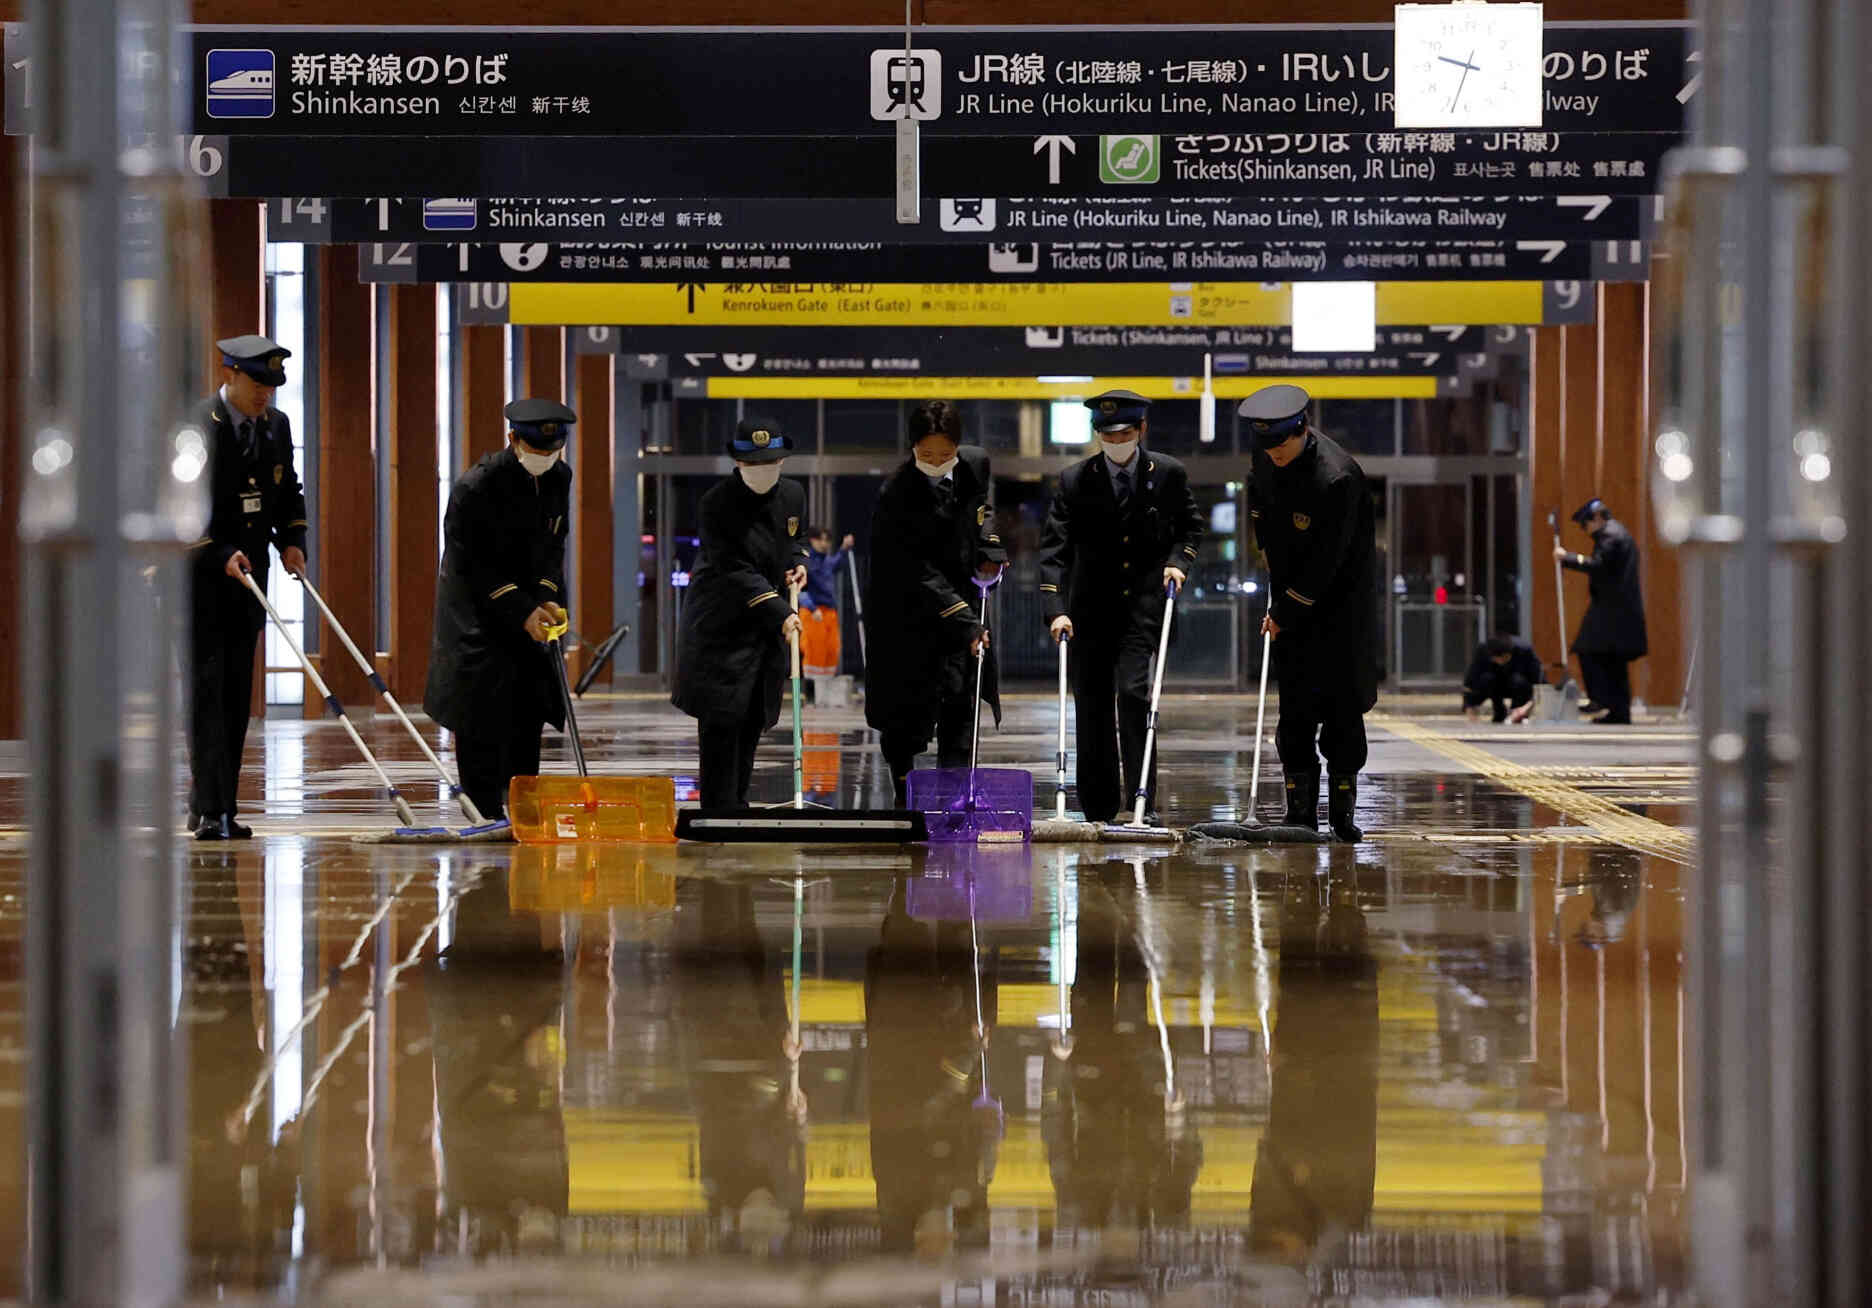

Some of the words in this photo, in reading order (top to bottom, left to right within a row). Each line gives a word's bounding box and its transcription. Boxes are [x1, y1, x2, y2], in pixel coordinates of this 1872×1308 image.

[291, 53, 509, 86] 新幹線のりば
[291, 91, 440, 115] Shinkansen
[458, 95, 517, 115] 신칸센
[531, 95, 591, 115] 新干线
[956, 94, 980, 114] JR
[988, 93, 1034, 114] Line
[1042, 92, 1151, 117] (Hokuriku
[1161, 93, 1212, 115] Line,
[1222, 94, 1296, 113] Nanao
[1305, 91, 1366, 116] Line),
[1375, 93, 1395, 112] IR
[1543, 90, 1600, 116] lway
[1173, 157, 1357, 182] Tickets(Shinkansen,
[1363, 158, 1384, 179] JR
[1391, 156, 1436, 181] Line)
[1453, 161, 1516, 178] 표사는곳
[281, 198, 327, 224] 14
[488, 208, 606, 228] Shinkansen
[619, 211, 665, 228] 신칸센
[1006, 210, 1026, 227] JR
[1032, 209, 1068, 227] Line
[1073, 208, 1160, 229] (Hokuriku
[1166, 209, 1206, 229] Line,
[1212, 210, 1272, 227] Nanao
[1277, 209, 1324, 228] Line),
[1331, 210, 1348, 226] IR
[1353, 208, 1432, 227] Ishikawa
[1438, 208, 1506, 229] Railway
[1050, 251, 1101, 269] Tickets
[1106, 251, 1128, 271] (JR
[1132, 251, 1168, 270] Line,
[1173, 252, 1187, 269] IR
[1191, 251, 1258, 269] Ishikawa
[1263, 250, 1327, 271] Railway)
[469, 283, 508, 310] 10
[723, 298, 793, 312] Kenrokuen
[797, 298, 828, 312] Gate
[838, 297, 870, 313] (East
[874, 297, 912, 313] Gate)
[1554, 280, 1581, 309] 9
[1072, 330, 1118, 345] Tickets
